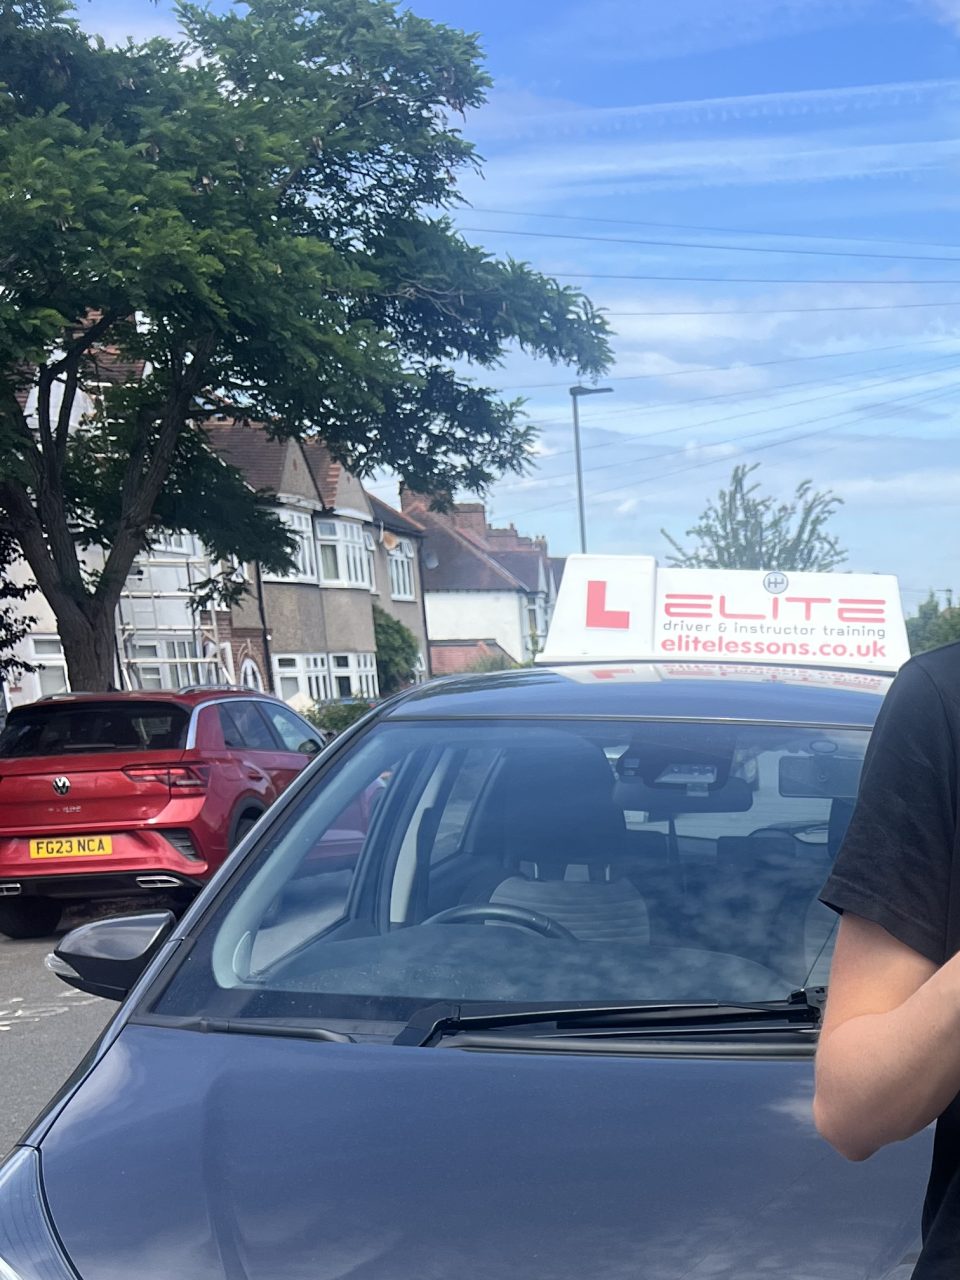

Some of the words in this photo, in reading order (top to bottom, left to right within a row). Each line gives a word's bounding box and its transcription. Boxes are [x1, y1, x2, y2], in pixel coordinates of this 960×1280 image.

[585, 580, 630, 630] L
[664, 593, 886, 623] ELITE
[663, 620, 712, 633] driver
[717, 622, 728, 633] &
[734, 621, 816, 637] instructor
[823, 626, 886, 640] training
[661, 635, 887, 658] elitelessons.co.uk
[36, 839, 73, 855] FG23
[77, 838, 105, 853] NCA
